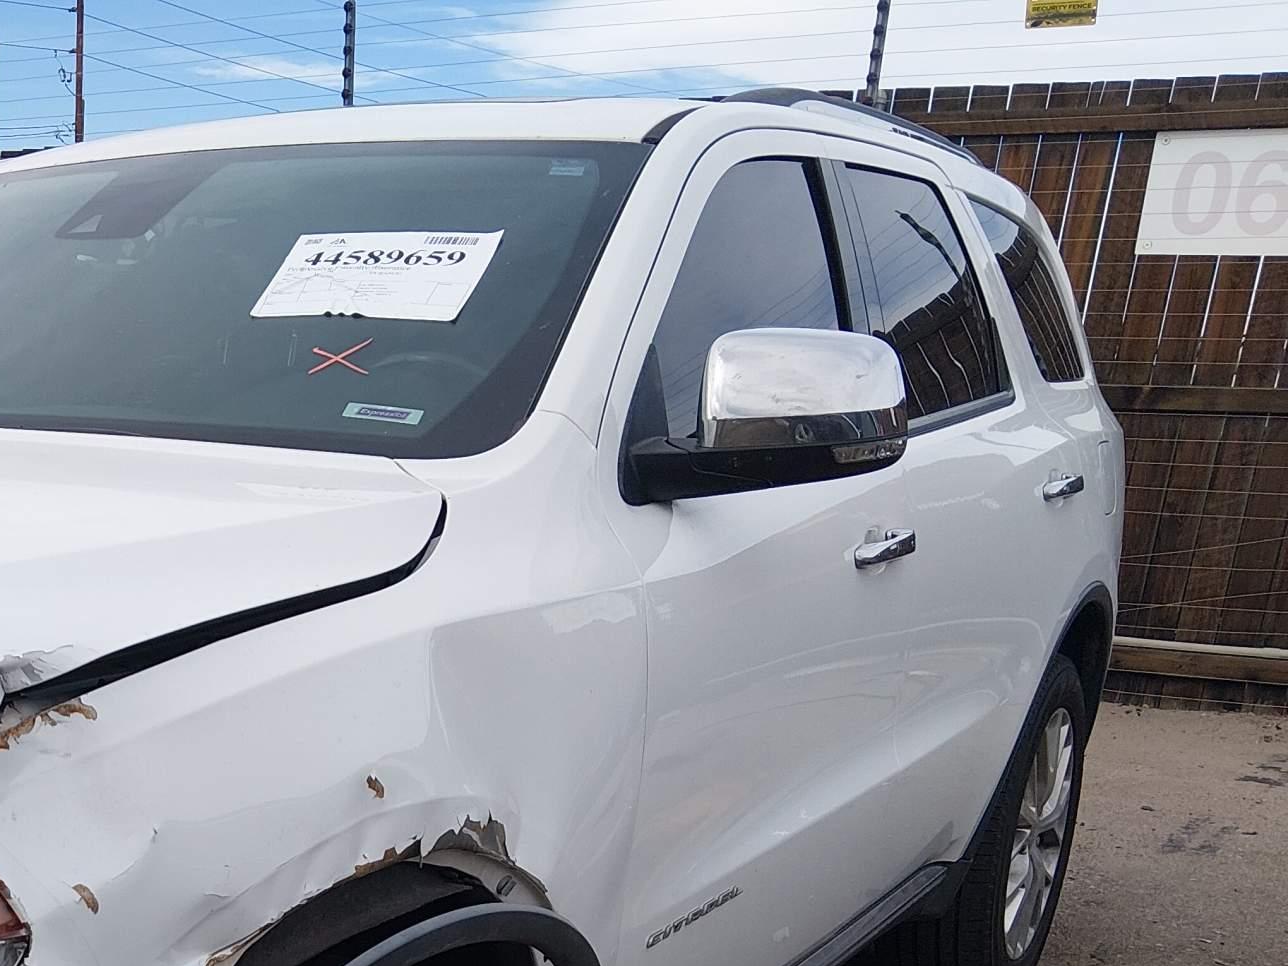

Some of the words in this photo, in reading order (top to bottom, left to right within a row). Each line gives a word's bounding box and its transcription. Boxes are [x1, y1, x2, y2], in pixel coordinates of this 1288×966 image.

[1031, 4, 1067, 12] SECURITY
[1068, 2, 1092, 10] FENCE
[1173, 150, 1288, 236] 06
[305, 250, 466, 266] 44589659
